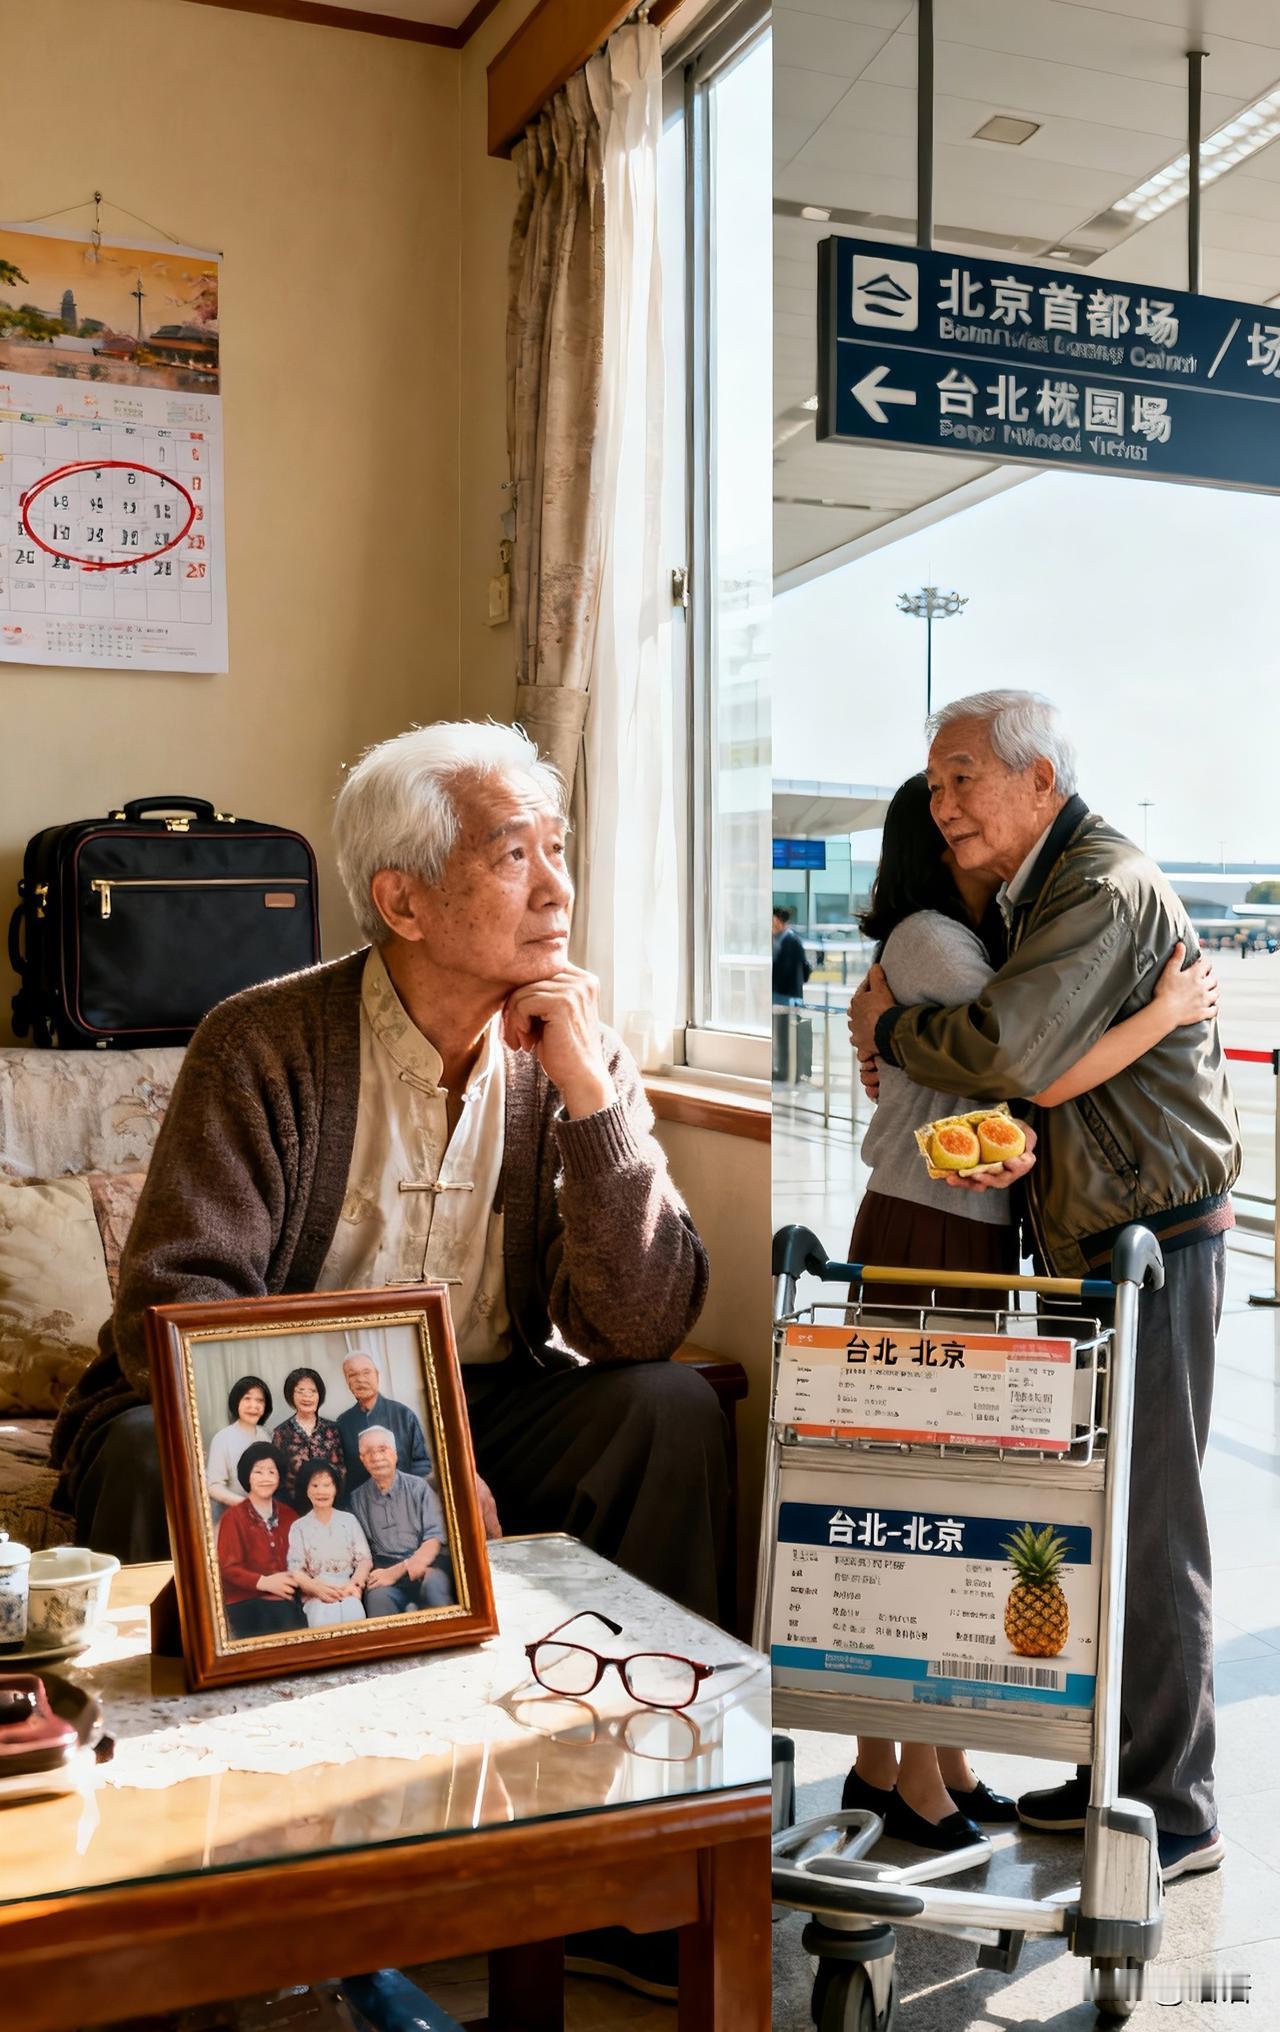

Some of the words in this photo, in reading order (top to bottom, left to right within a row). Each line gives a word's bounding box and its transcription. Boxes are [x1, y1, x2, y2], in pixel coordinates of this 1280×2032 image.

[937, 268, 1180, 349] 北京首都场
[846, 1333, 899, 1366] 台北
[910, 1337, 967, 1370] 北京
[828, 1509, 966, 1553] 台北-北京
